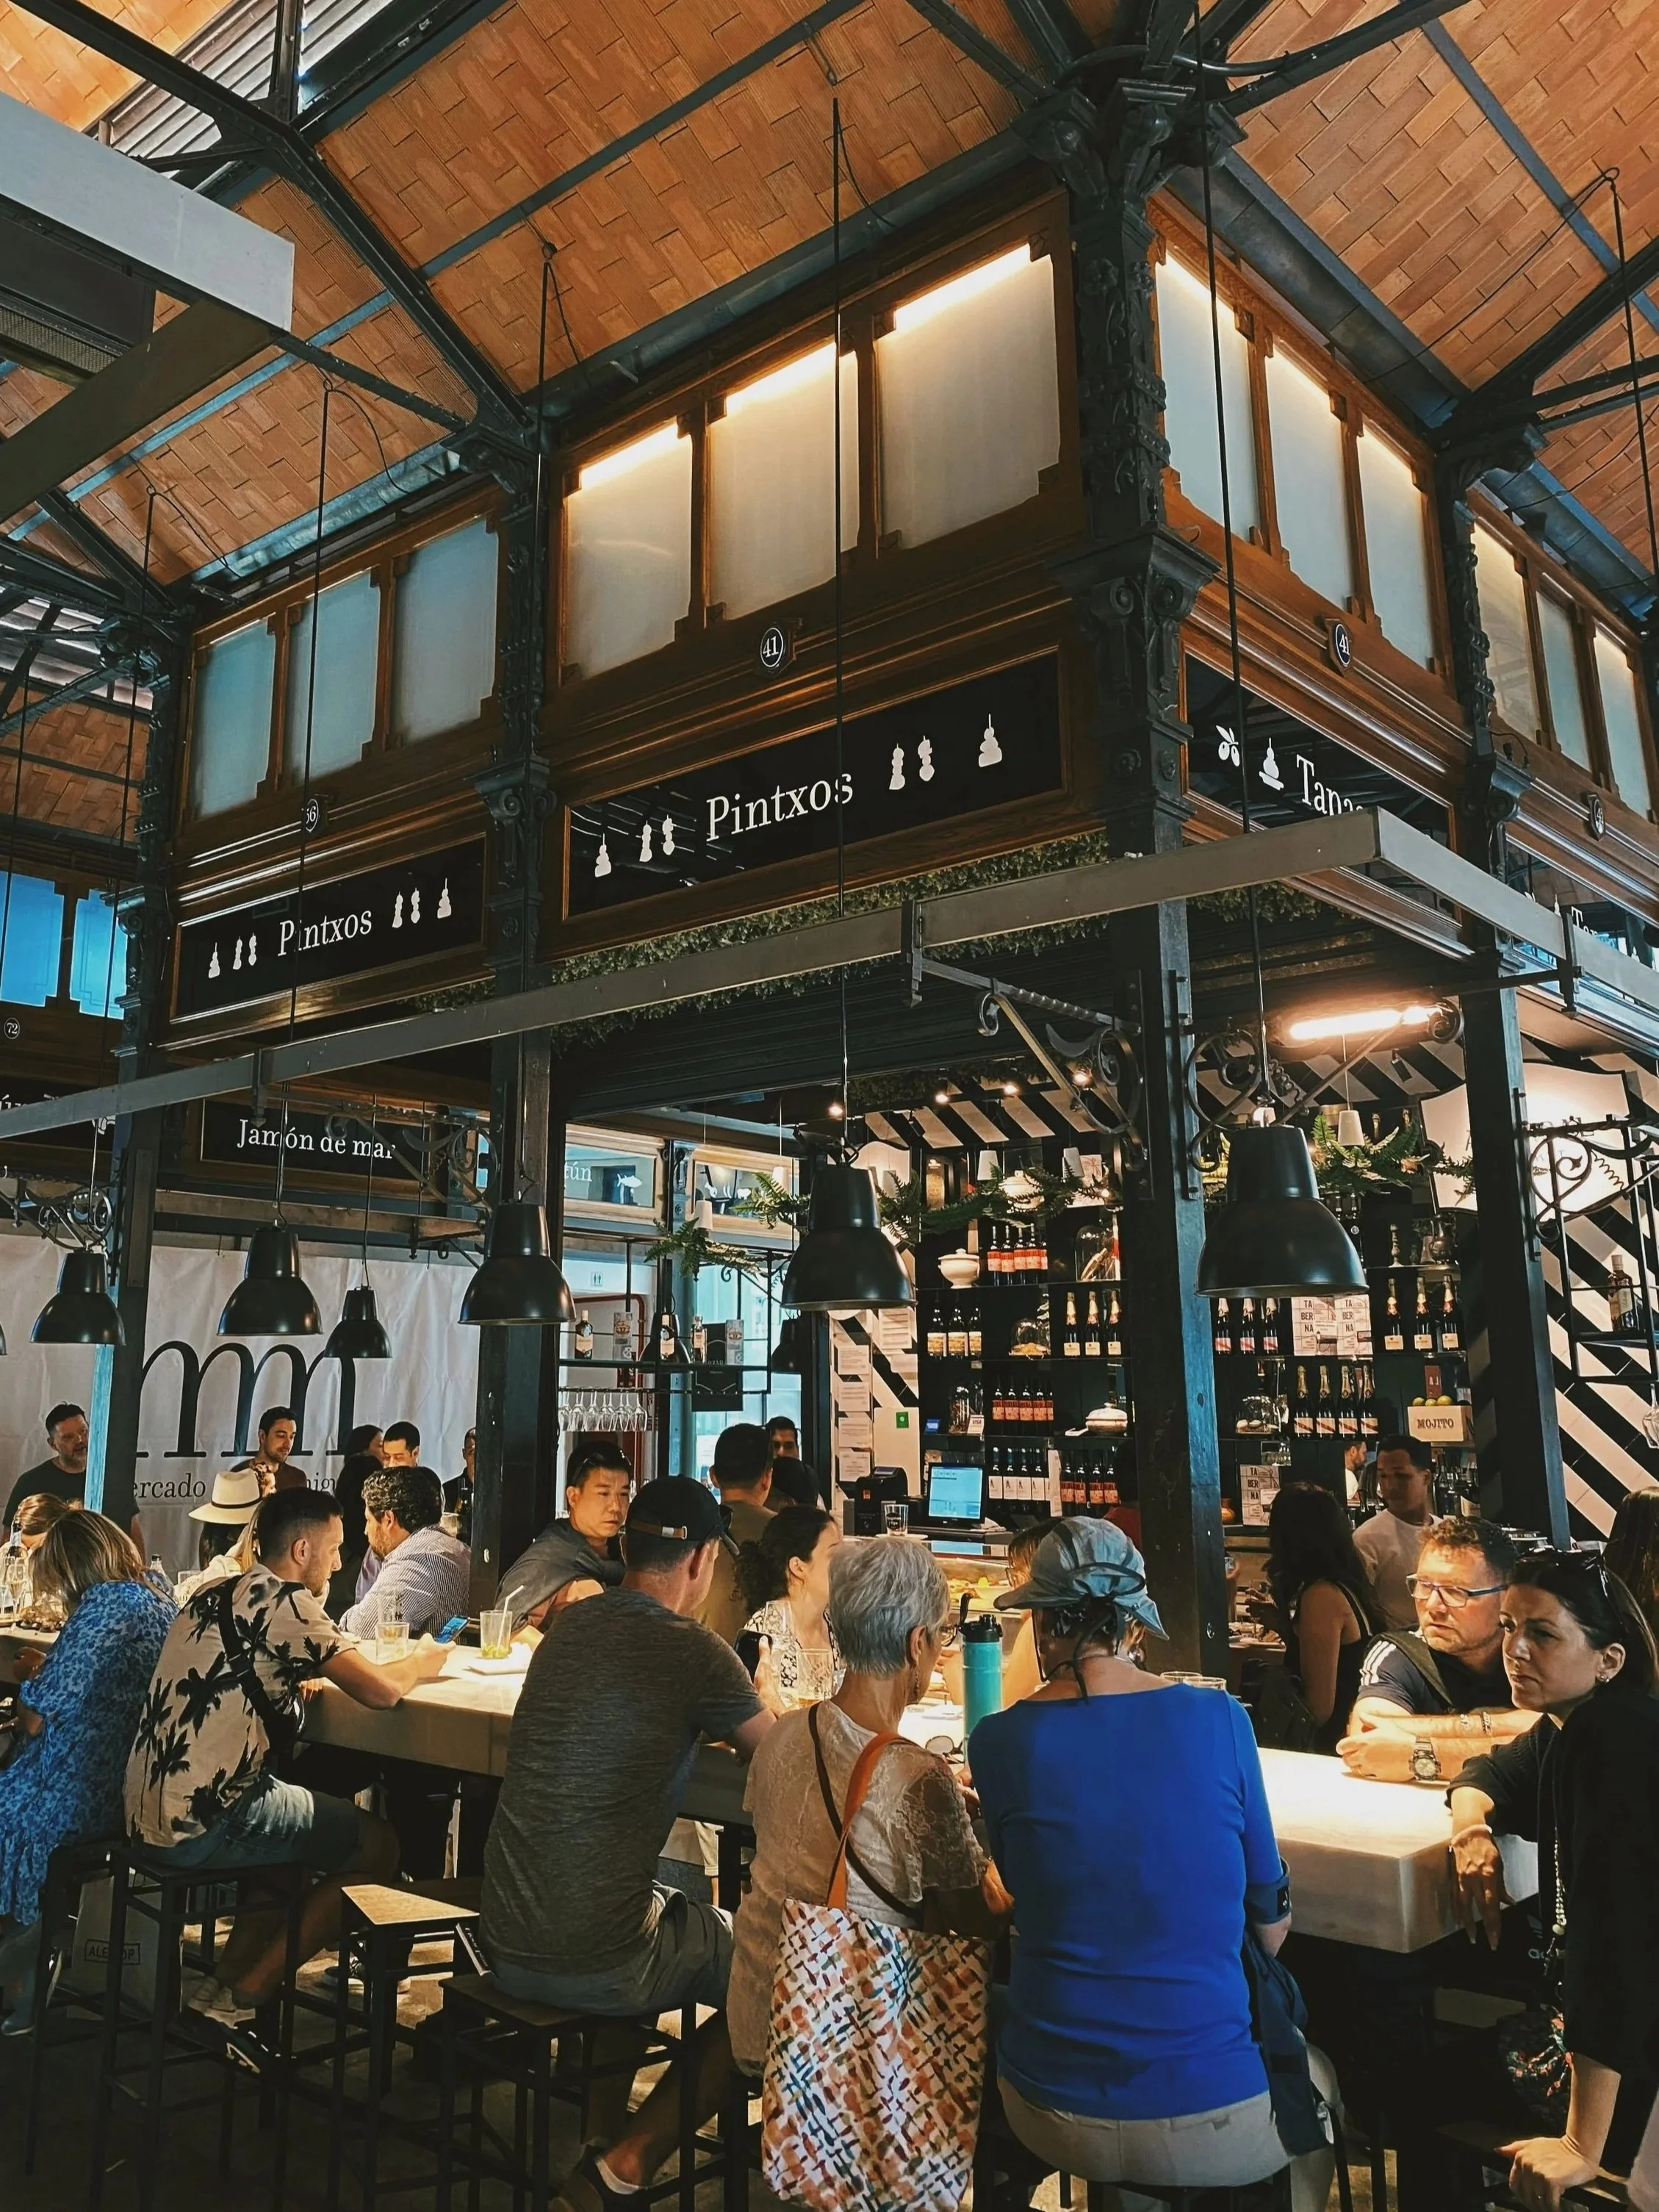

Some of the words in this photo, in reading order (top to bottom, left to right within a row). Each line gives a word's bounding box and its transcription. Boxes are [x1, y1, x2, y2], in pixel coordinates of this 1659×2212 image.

[763, 636, 779, 658] 41
[1339, 633, 1350, 656] 41
[1297, 754, 1363, 816] Tap
[706, 773, 853, 842] Pintxos
[7, 1022, 18, 1034] 72
[237, 1118, 315, 1152] Jamón
[1304, 1299, 1313, 1308] TA
[1345, 1299, 1353, 1307] TA
[1301, 1312, 1314, 1321] BER
[1342, 1311, 1353, 1320] BER
[1304, 1324, 1314, 1332] NA
[1345, 1324, 1353, 1332] NA
[1417, 1418, 1454, 1429] MOJITO
[1250, 1467, 1258, 1476] TA
[1248, 1479, 1259, 1488] BER
[1250, 1491, 1259, 1500] NA
